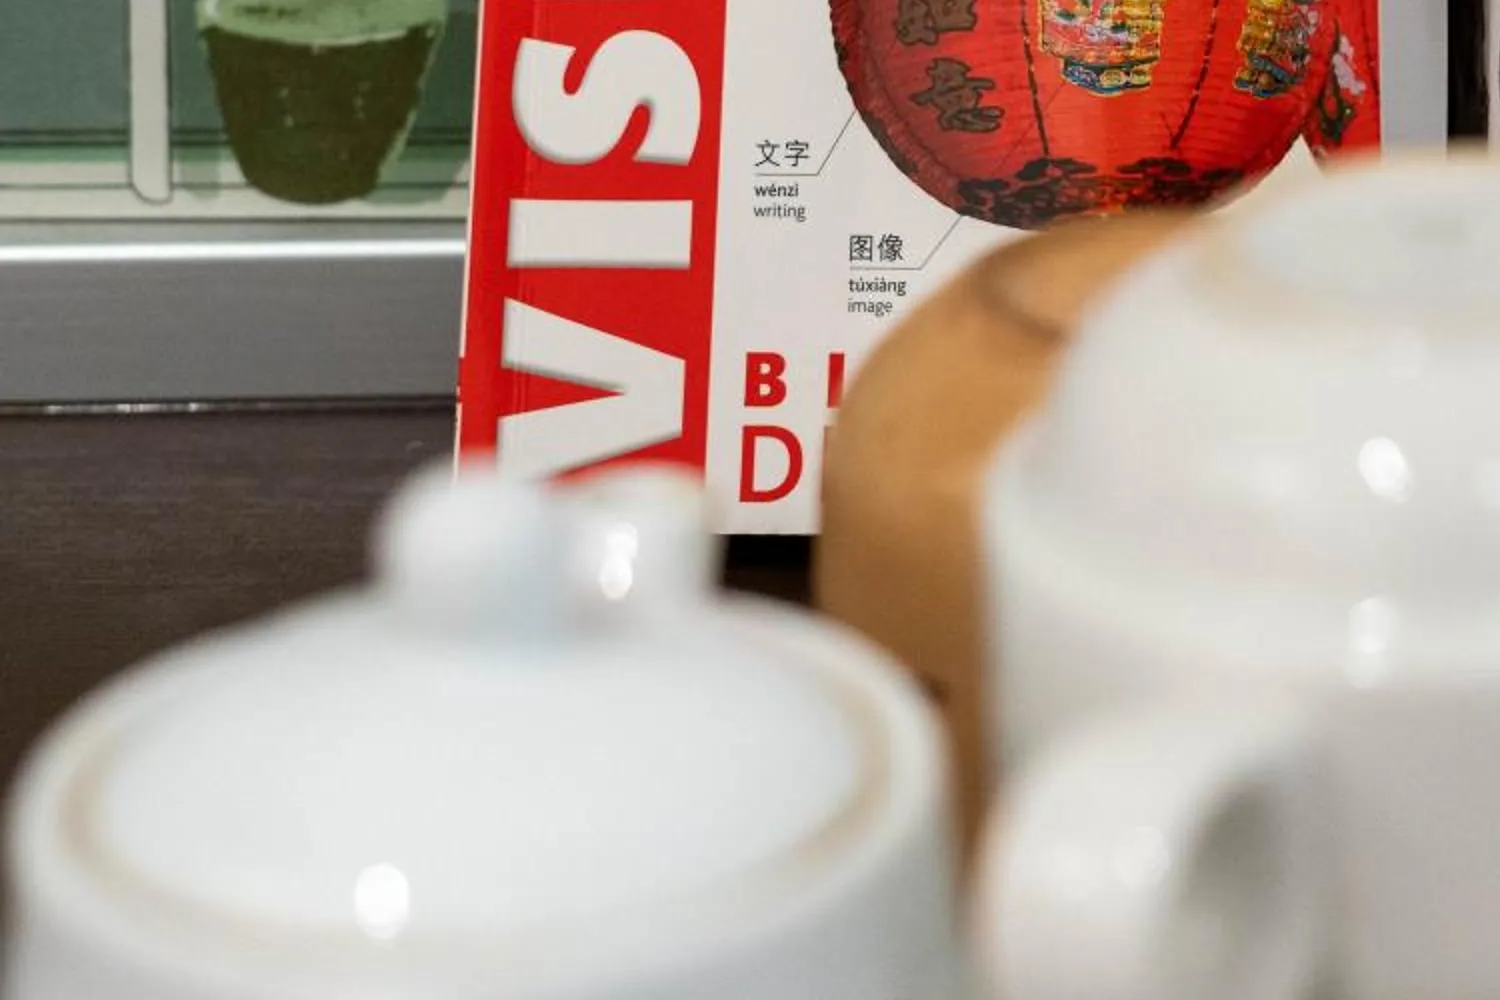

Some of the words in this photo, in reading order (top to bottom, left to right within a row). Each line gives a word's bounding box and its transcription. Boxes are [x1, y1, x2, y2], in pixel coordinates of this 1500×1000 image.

[754, 139, 810, 167] 文字
[753, 203, 806, 223] writing
[849, 233, 904, 262] 图像
[847, 298, 893, 317] image
